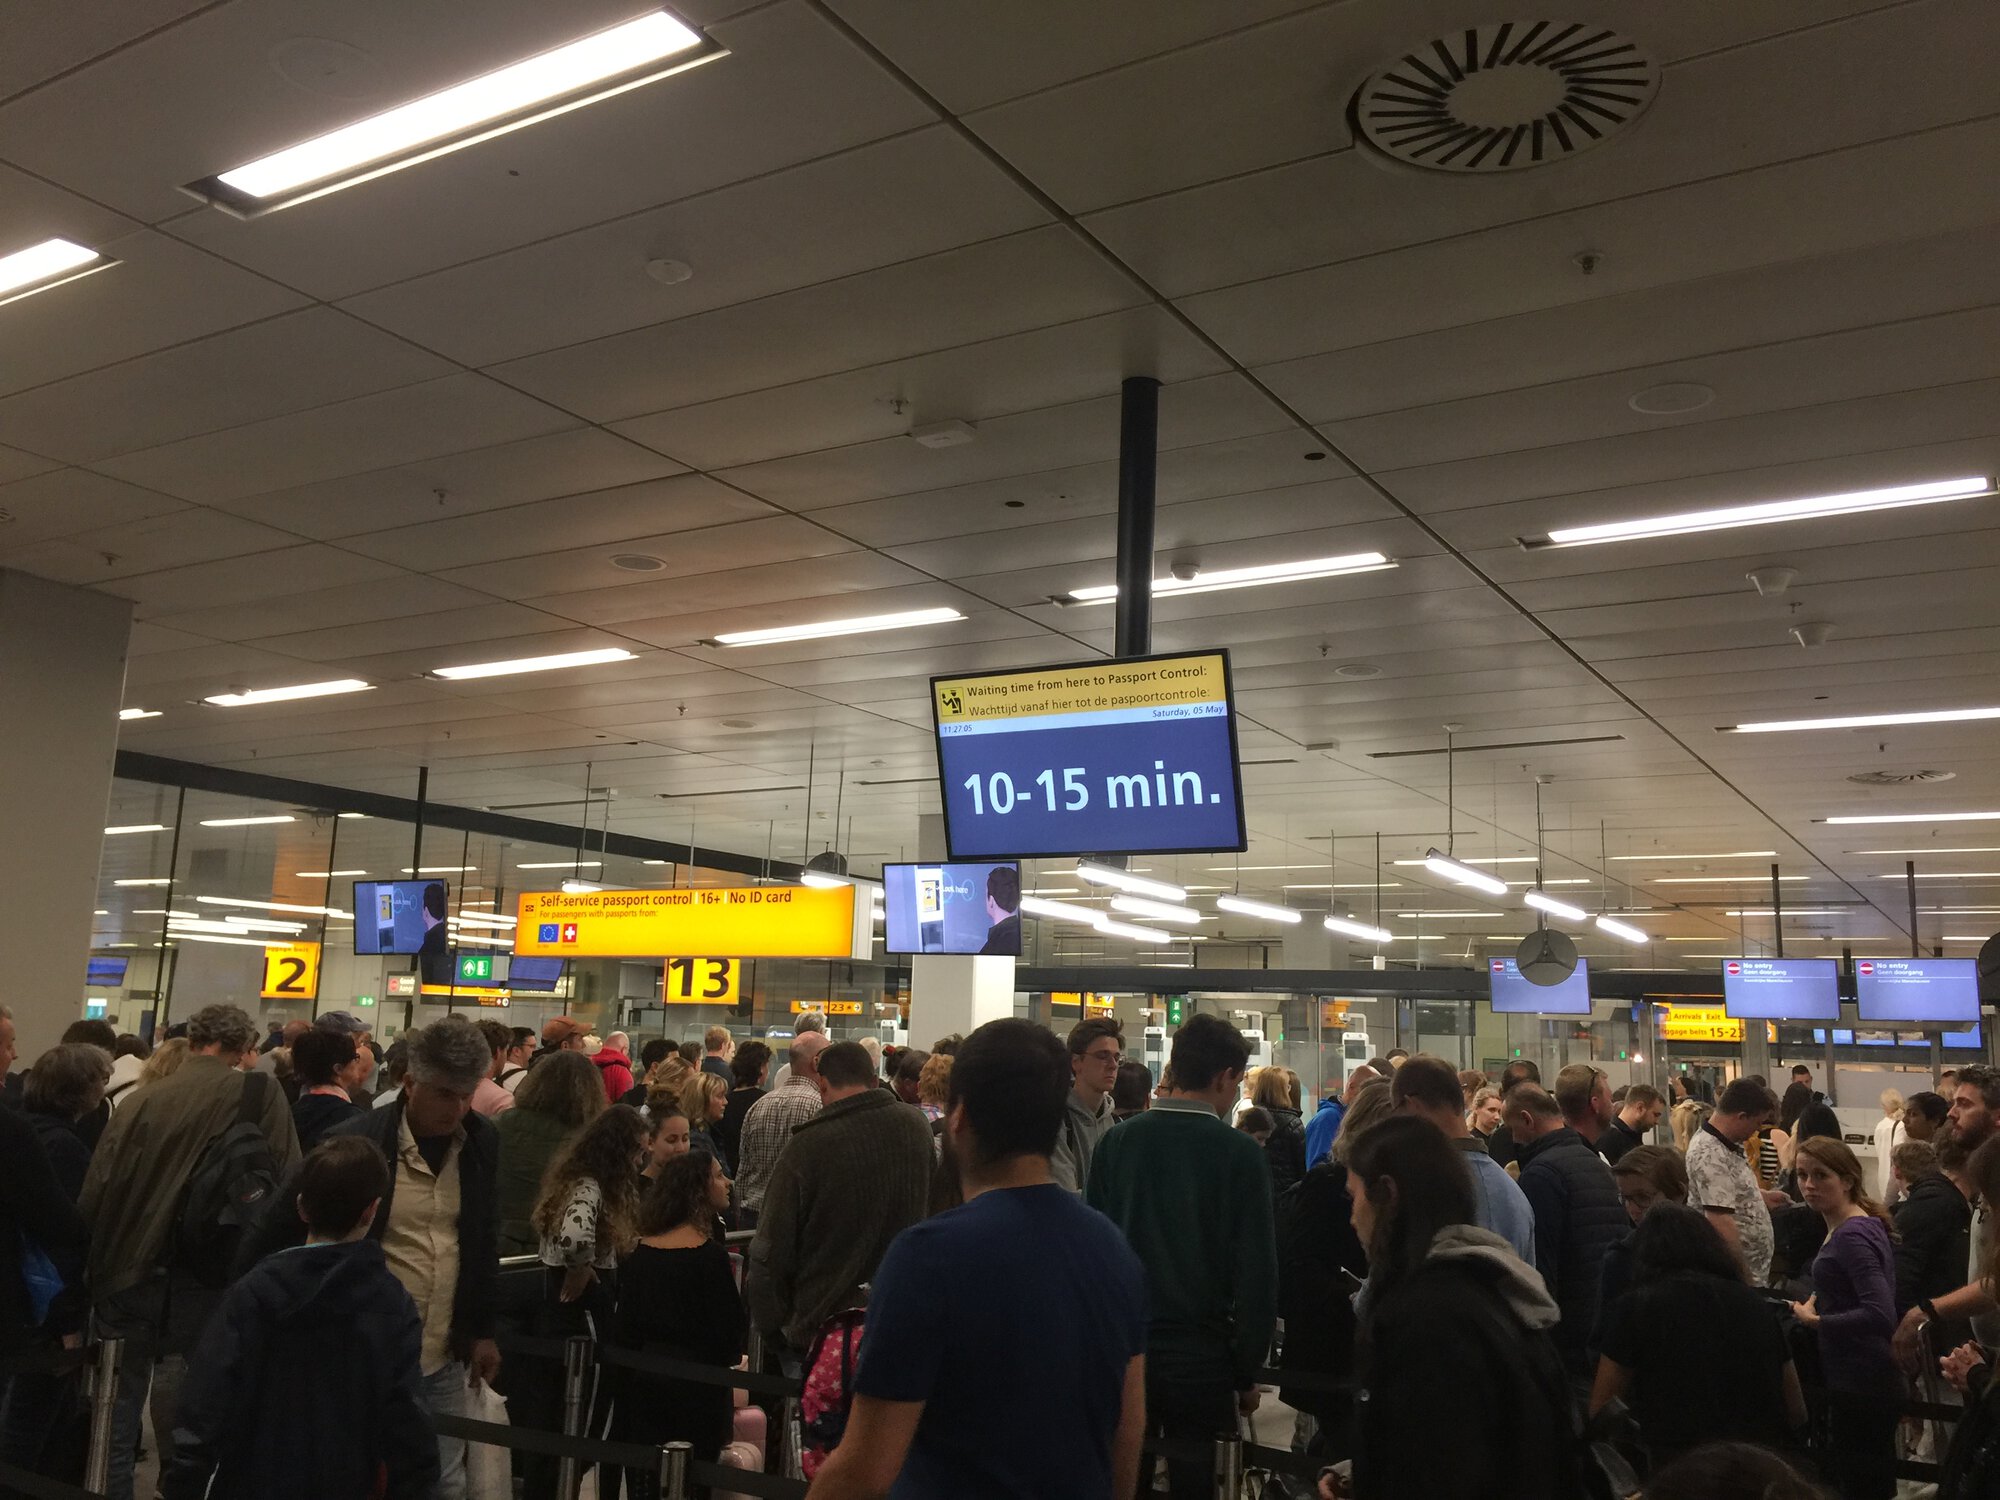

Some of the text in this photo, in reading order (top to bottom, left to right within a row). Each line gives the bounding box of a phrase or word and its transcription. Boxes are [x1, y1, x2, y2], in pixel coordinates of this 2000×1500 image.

[967, 666, 1207, 697] Waiting time from here to Passport Control:
[969, 687, 1210, 716] Wachttijd vanaf hier tot de paspoortcontrole:
[1152, 705, 1224, 718] Saturday, 05 May
[964, 760, 1220, 815] 10-15 min.
[540, 890, 792, 908] Self-service passport control 16+ No ID card
[552, 911, 587, 919] passengers
[589, 910, 603, 918] with
[605, 910, 637, 919] passports
[669, 958, 730, 998] 13
